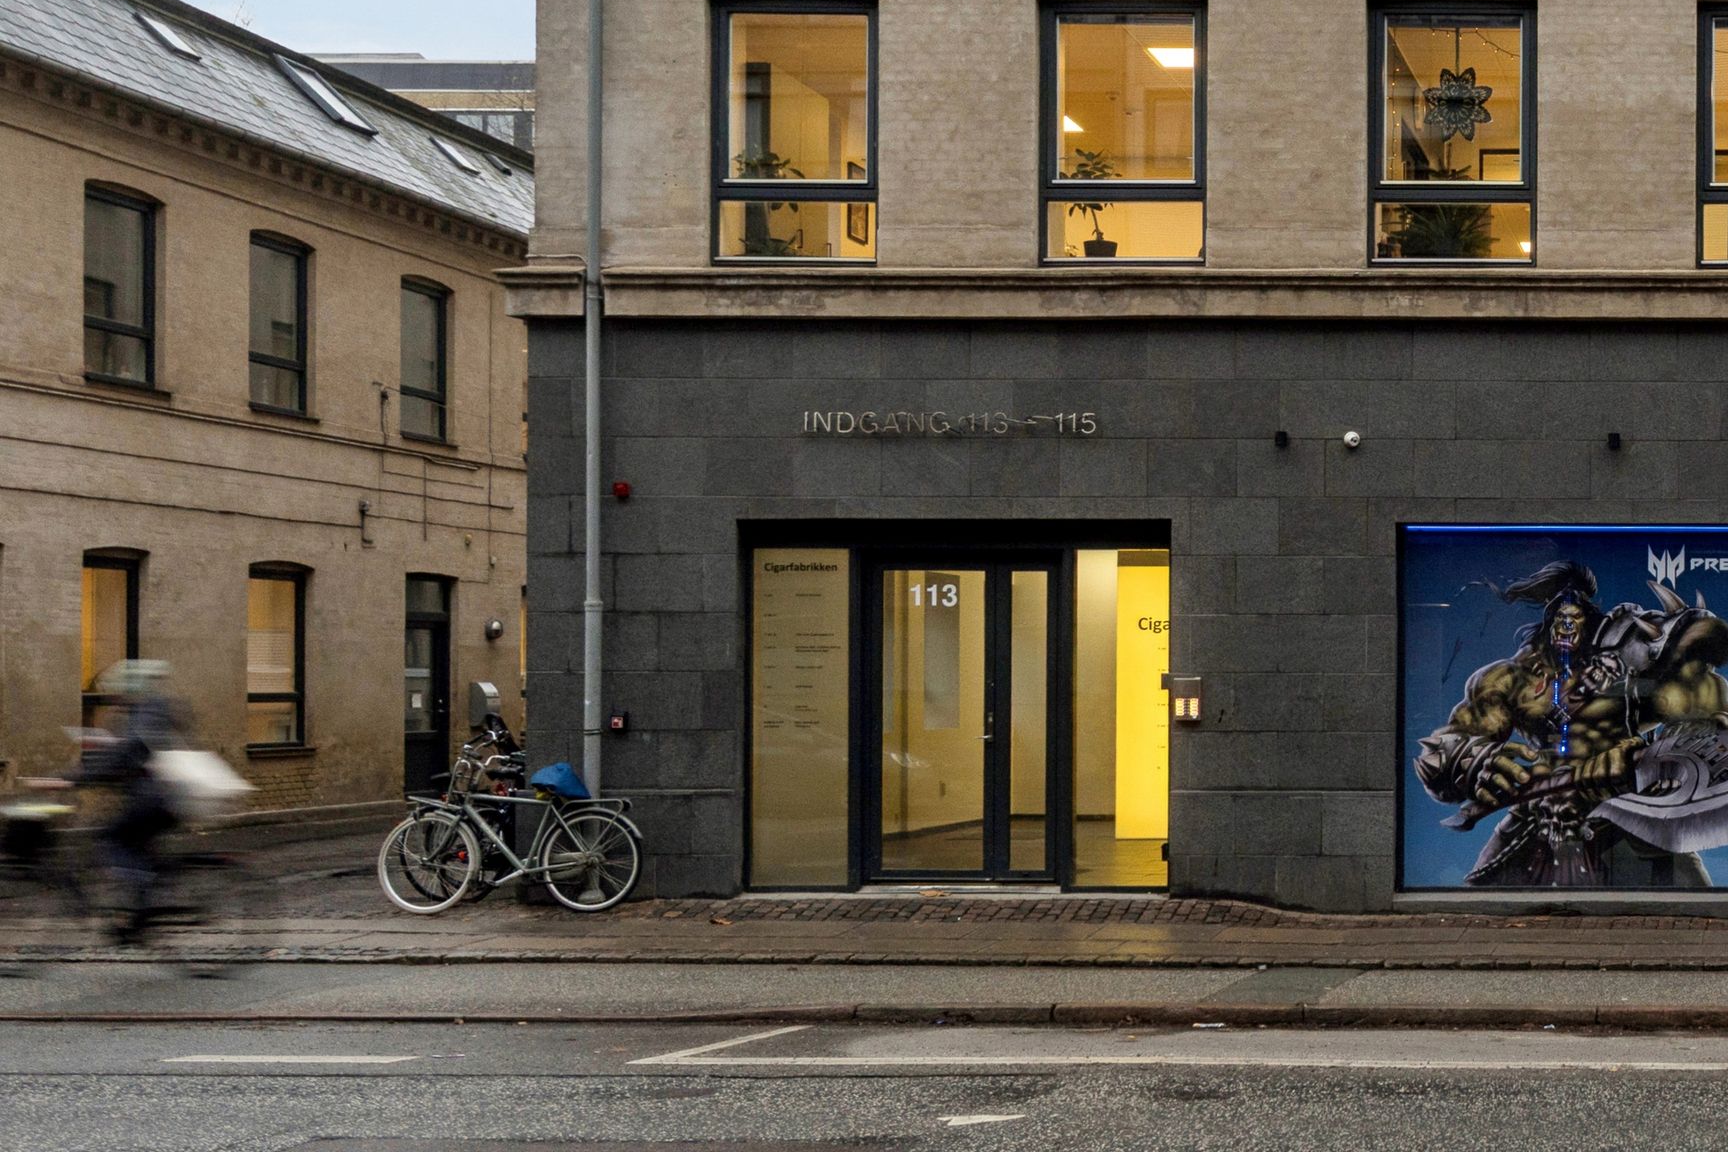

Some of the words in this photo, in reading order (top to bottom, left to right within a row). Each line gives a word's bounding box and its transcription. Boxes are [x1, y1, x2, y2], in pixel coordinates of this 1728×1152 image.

[803, 410, 950, 434] INDGANG
[1054, 411, 1097, 434] 115
[763, 562, 838, 574] Cigarfabrikken
[909, 583, 958, 607] 113
